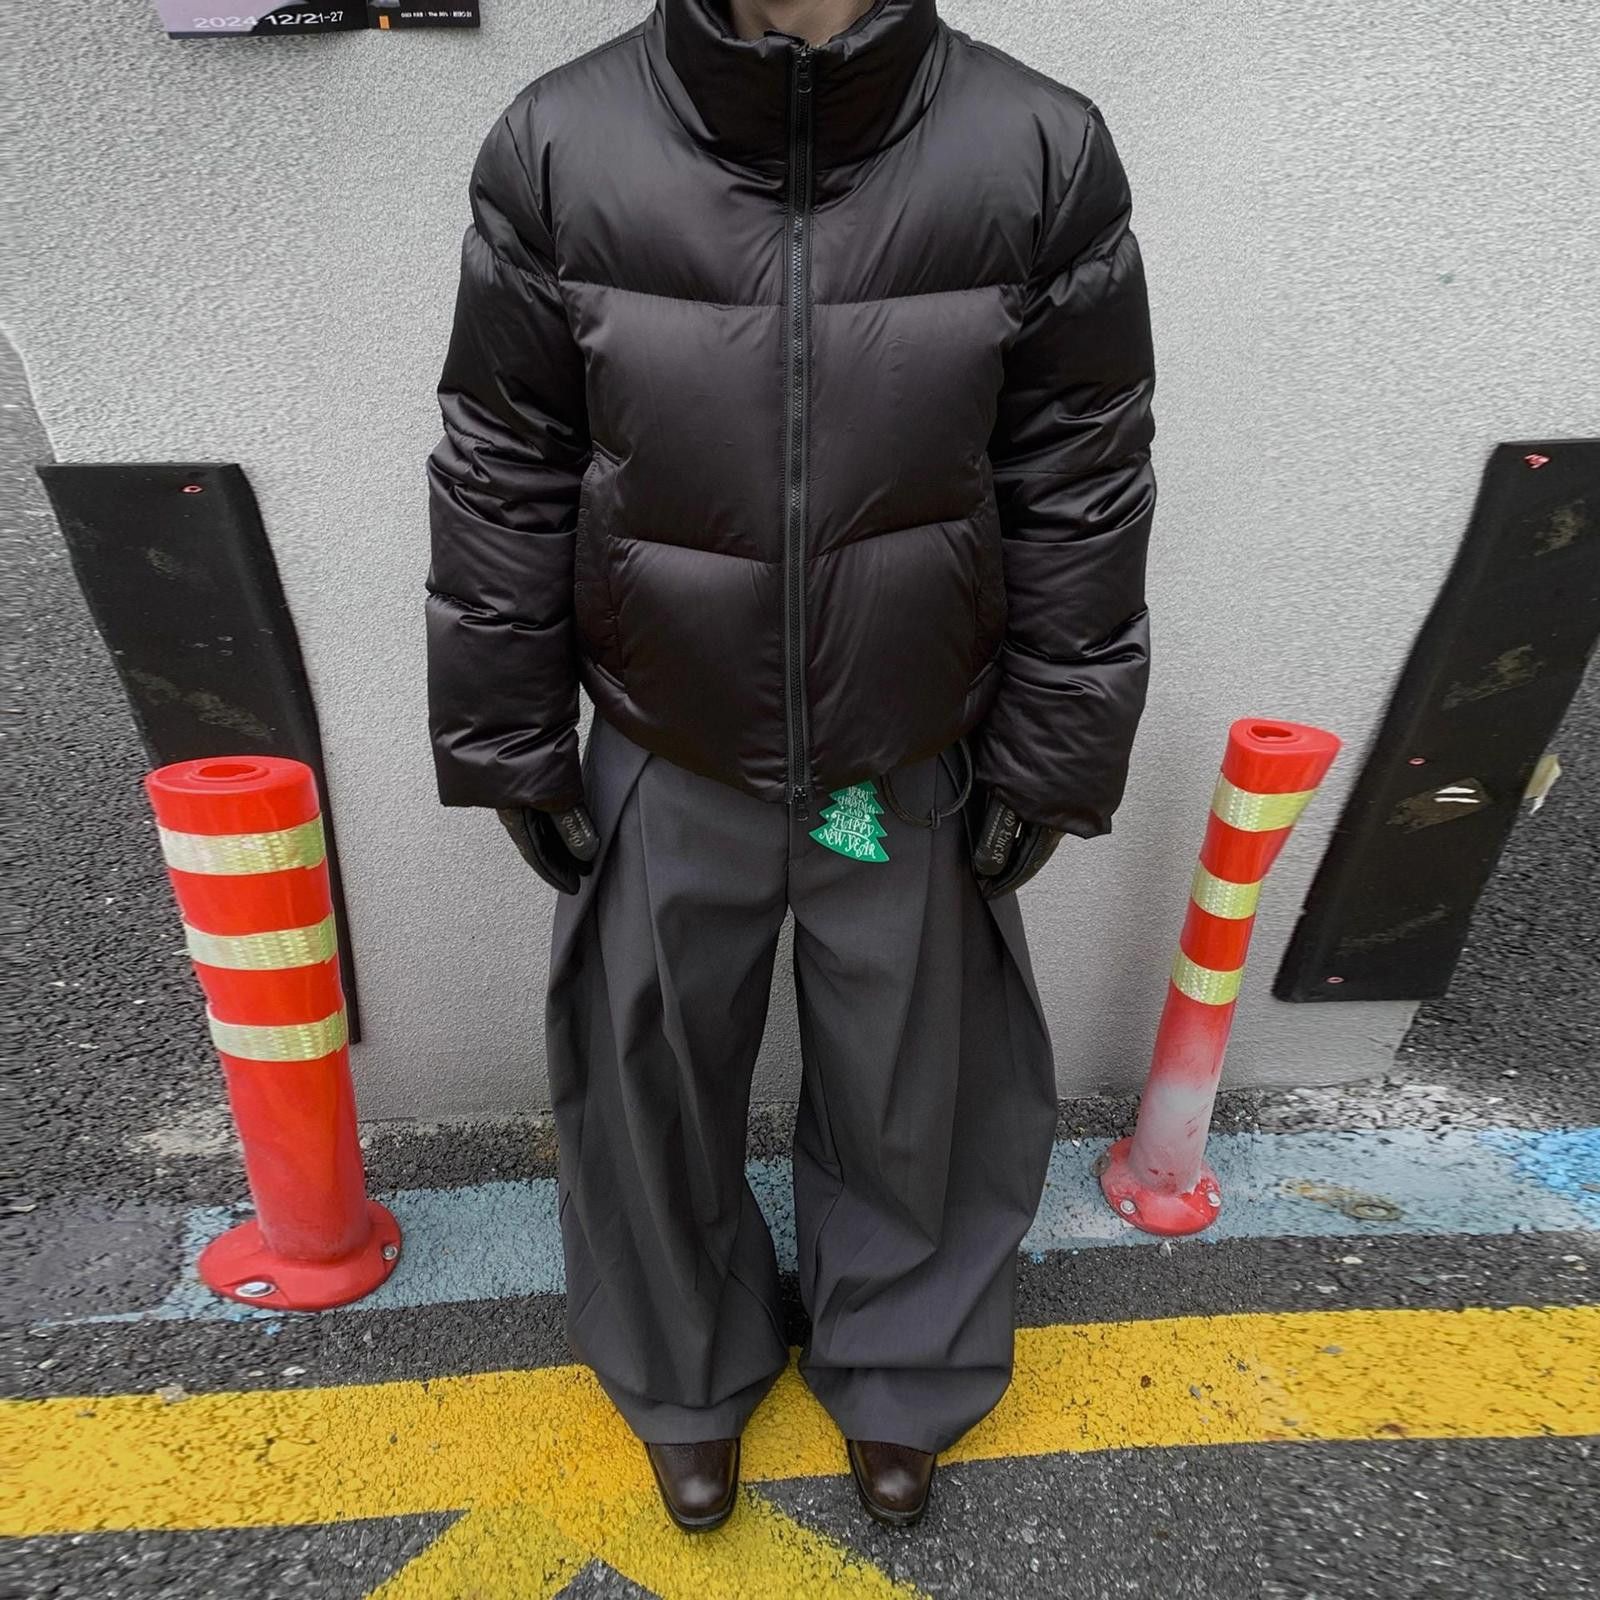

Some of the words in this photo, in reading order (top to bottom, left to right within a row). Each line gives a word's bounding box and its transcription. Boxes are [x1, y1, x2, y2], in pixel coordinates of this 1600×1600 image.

[193, 15, 258, 29] 2024
[264, 11, 344, 26] 12/21-27
[832, 814, 874, 836] HAPPY
[819, 828, 845, 847] NEW
[845, 835, 876, 859] YEAR
